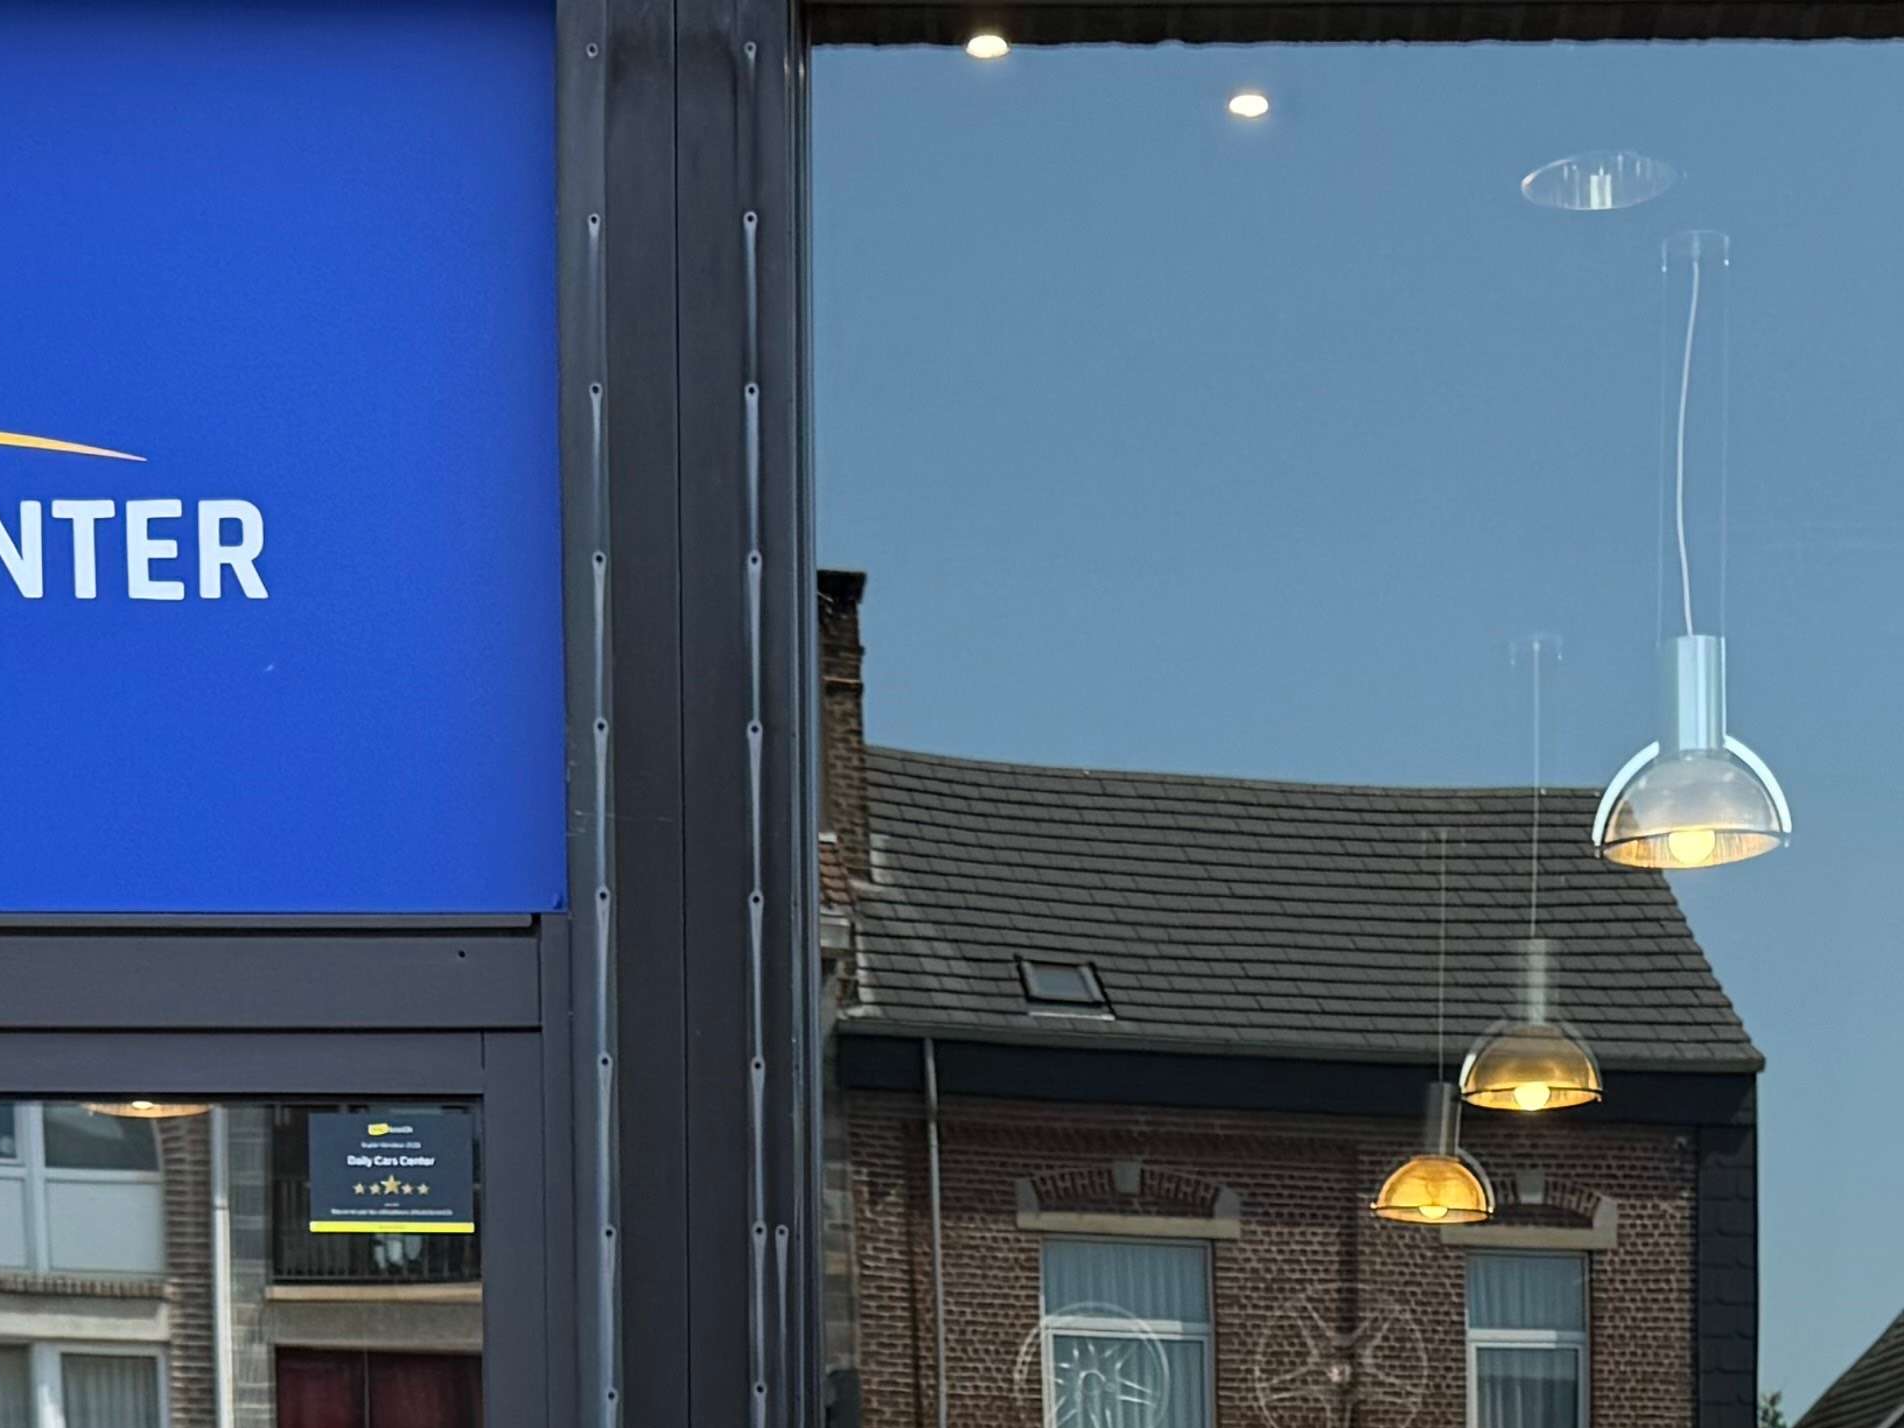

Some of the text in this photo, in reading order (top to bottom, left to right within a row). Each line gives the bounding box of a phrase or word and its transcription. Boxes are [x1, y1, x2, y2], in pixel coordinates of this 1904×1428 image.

[347, 1155, 436, 1168] Daily Cars Center
